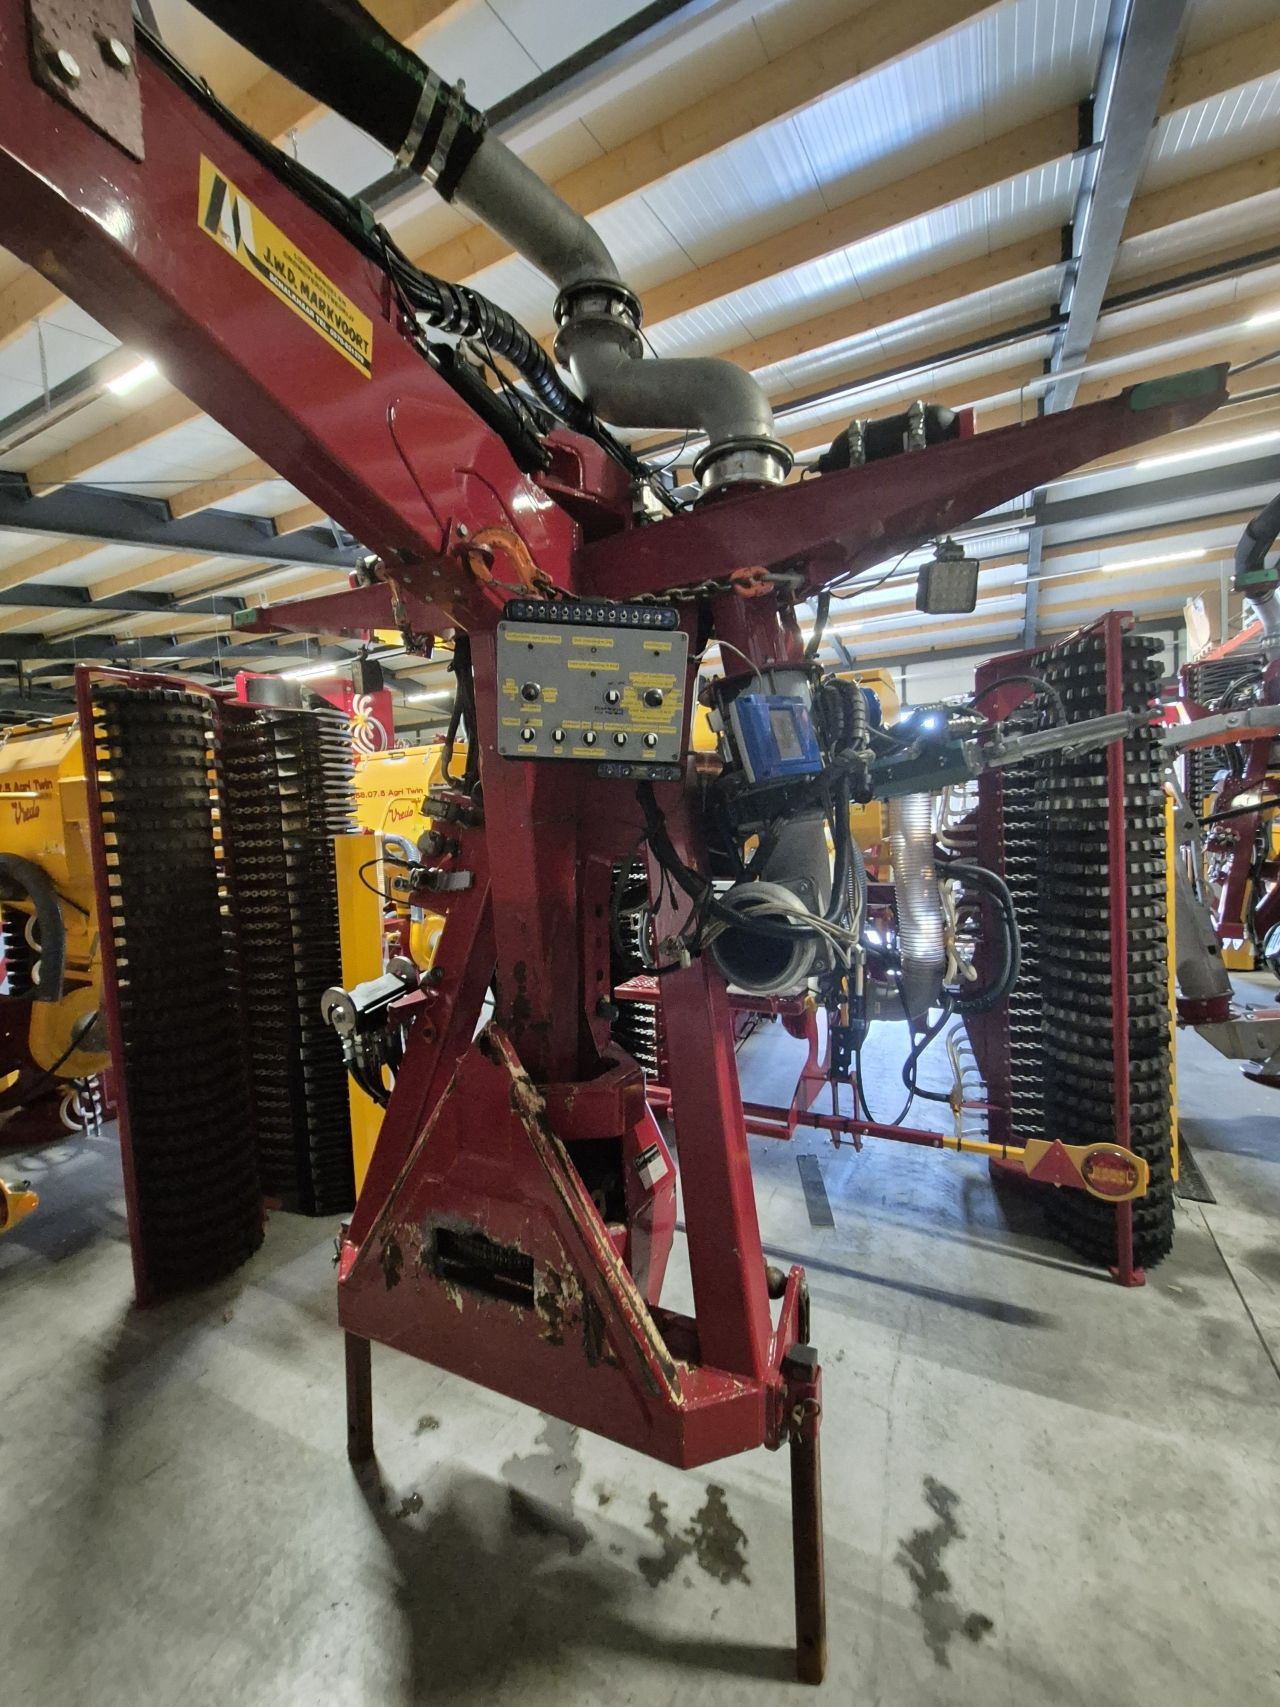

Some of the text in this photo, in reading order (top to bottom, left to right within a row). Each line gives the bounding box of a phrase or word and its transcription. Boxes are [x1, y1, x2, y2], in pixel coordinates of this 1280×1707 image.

[264, 247, 368, 356] J.W.D. MARKVOORT
[315, 314, 328, 331] TEL.
[33, 778, 53, 790] Twin
[388, 788, 404, 797] Agri
[407, 787, 423, 795] Twin
[11, 800, 40, 824] Vredo
[389, 806, 414, 821] Vredo
